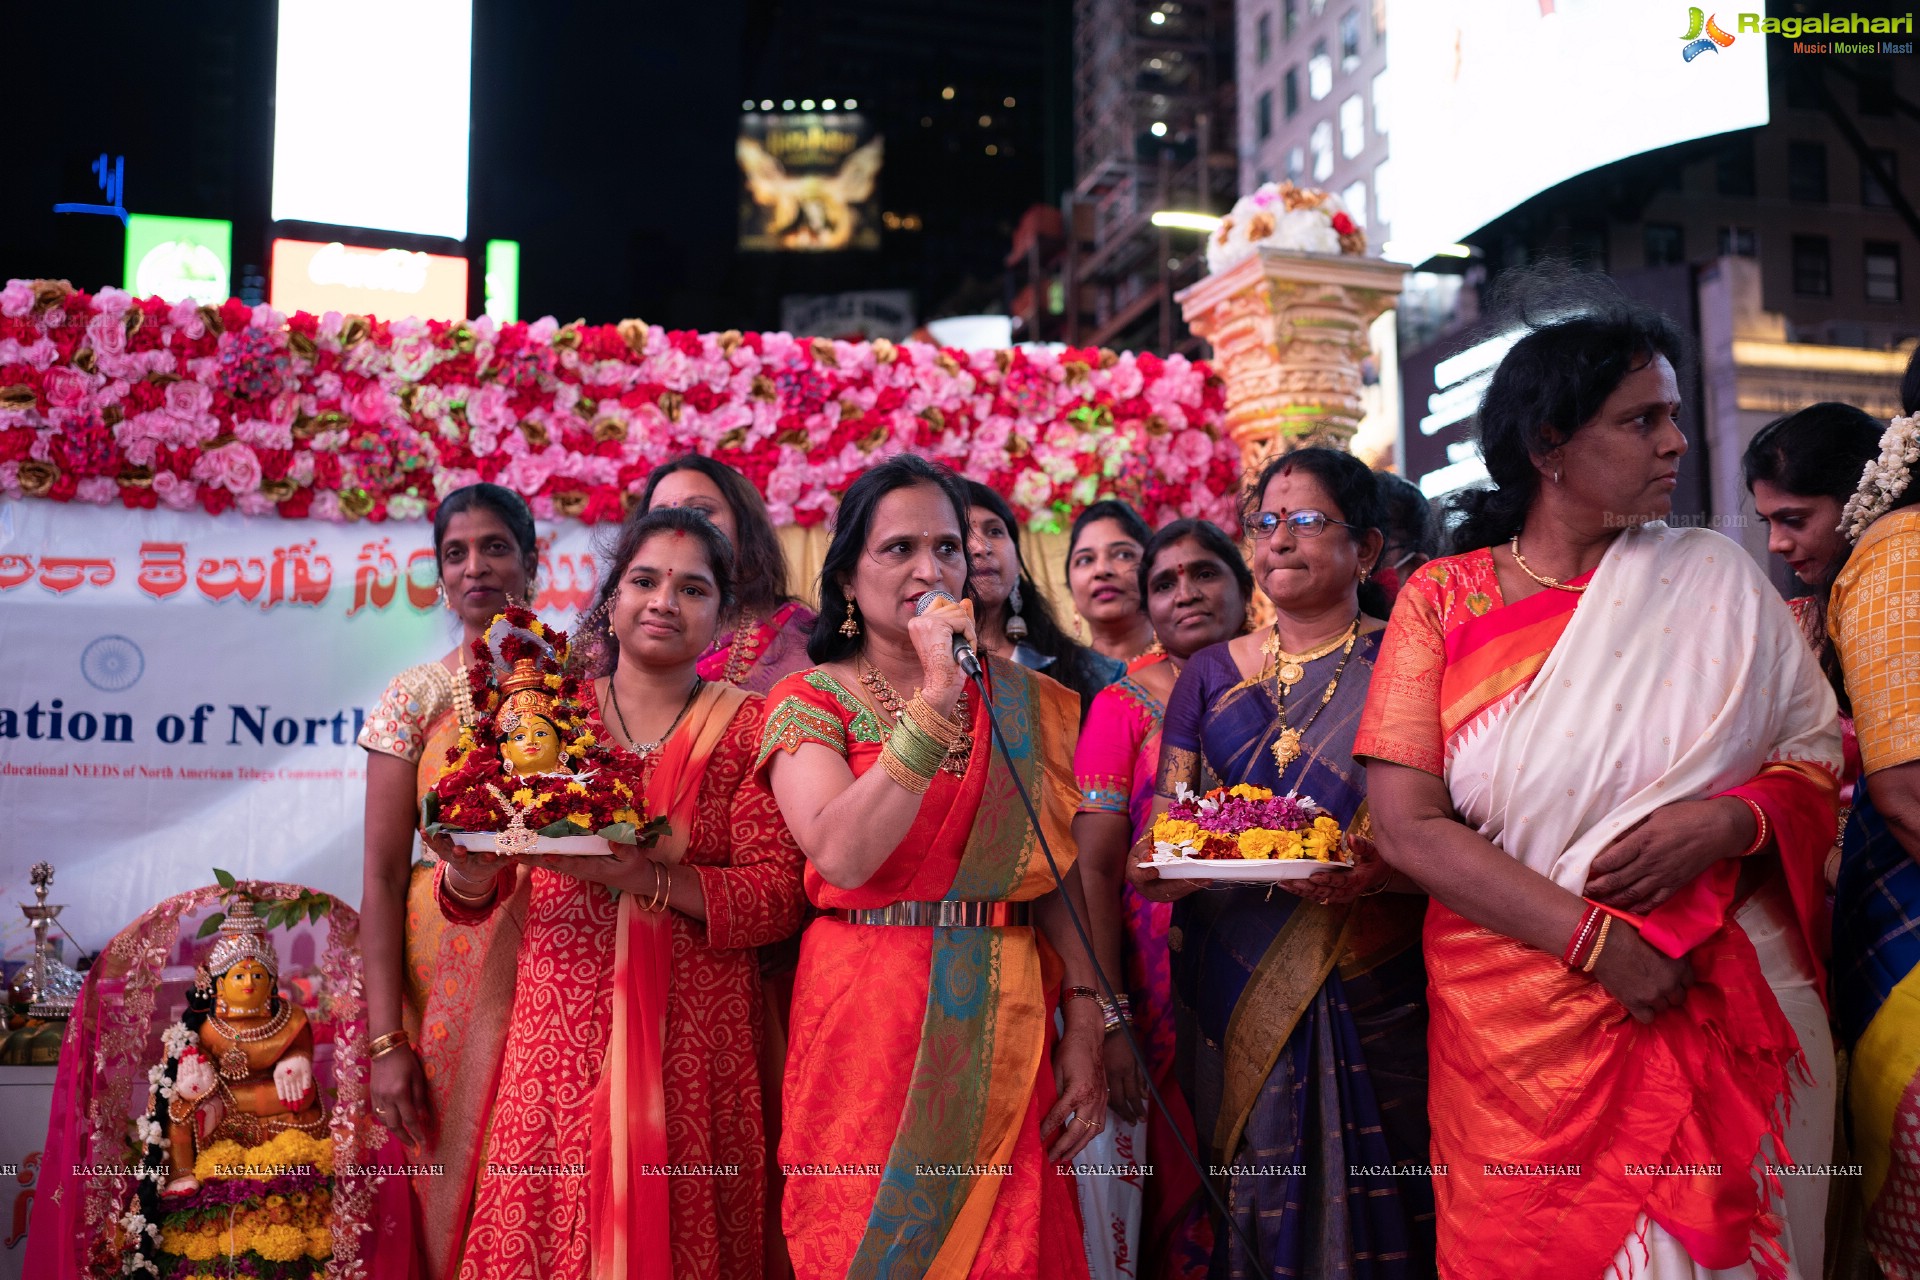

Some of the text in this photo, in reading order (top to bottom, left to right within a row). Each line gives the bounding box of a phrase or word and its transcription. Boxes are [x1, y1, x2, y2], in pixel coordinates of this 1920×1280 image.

[156, 703, 215, 745] of
[73, 763, 119, 778] NEEDS
[123, 763, 135, 778] of
[138, 764, 174, 779] North
